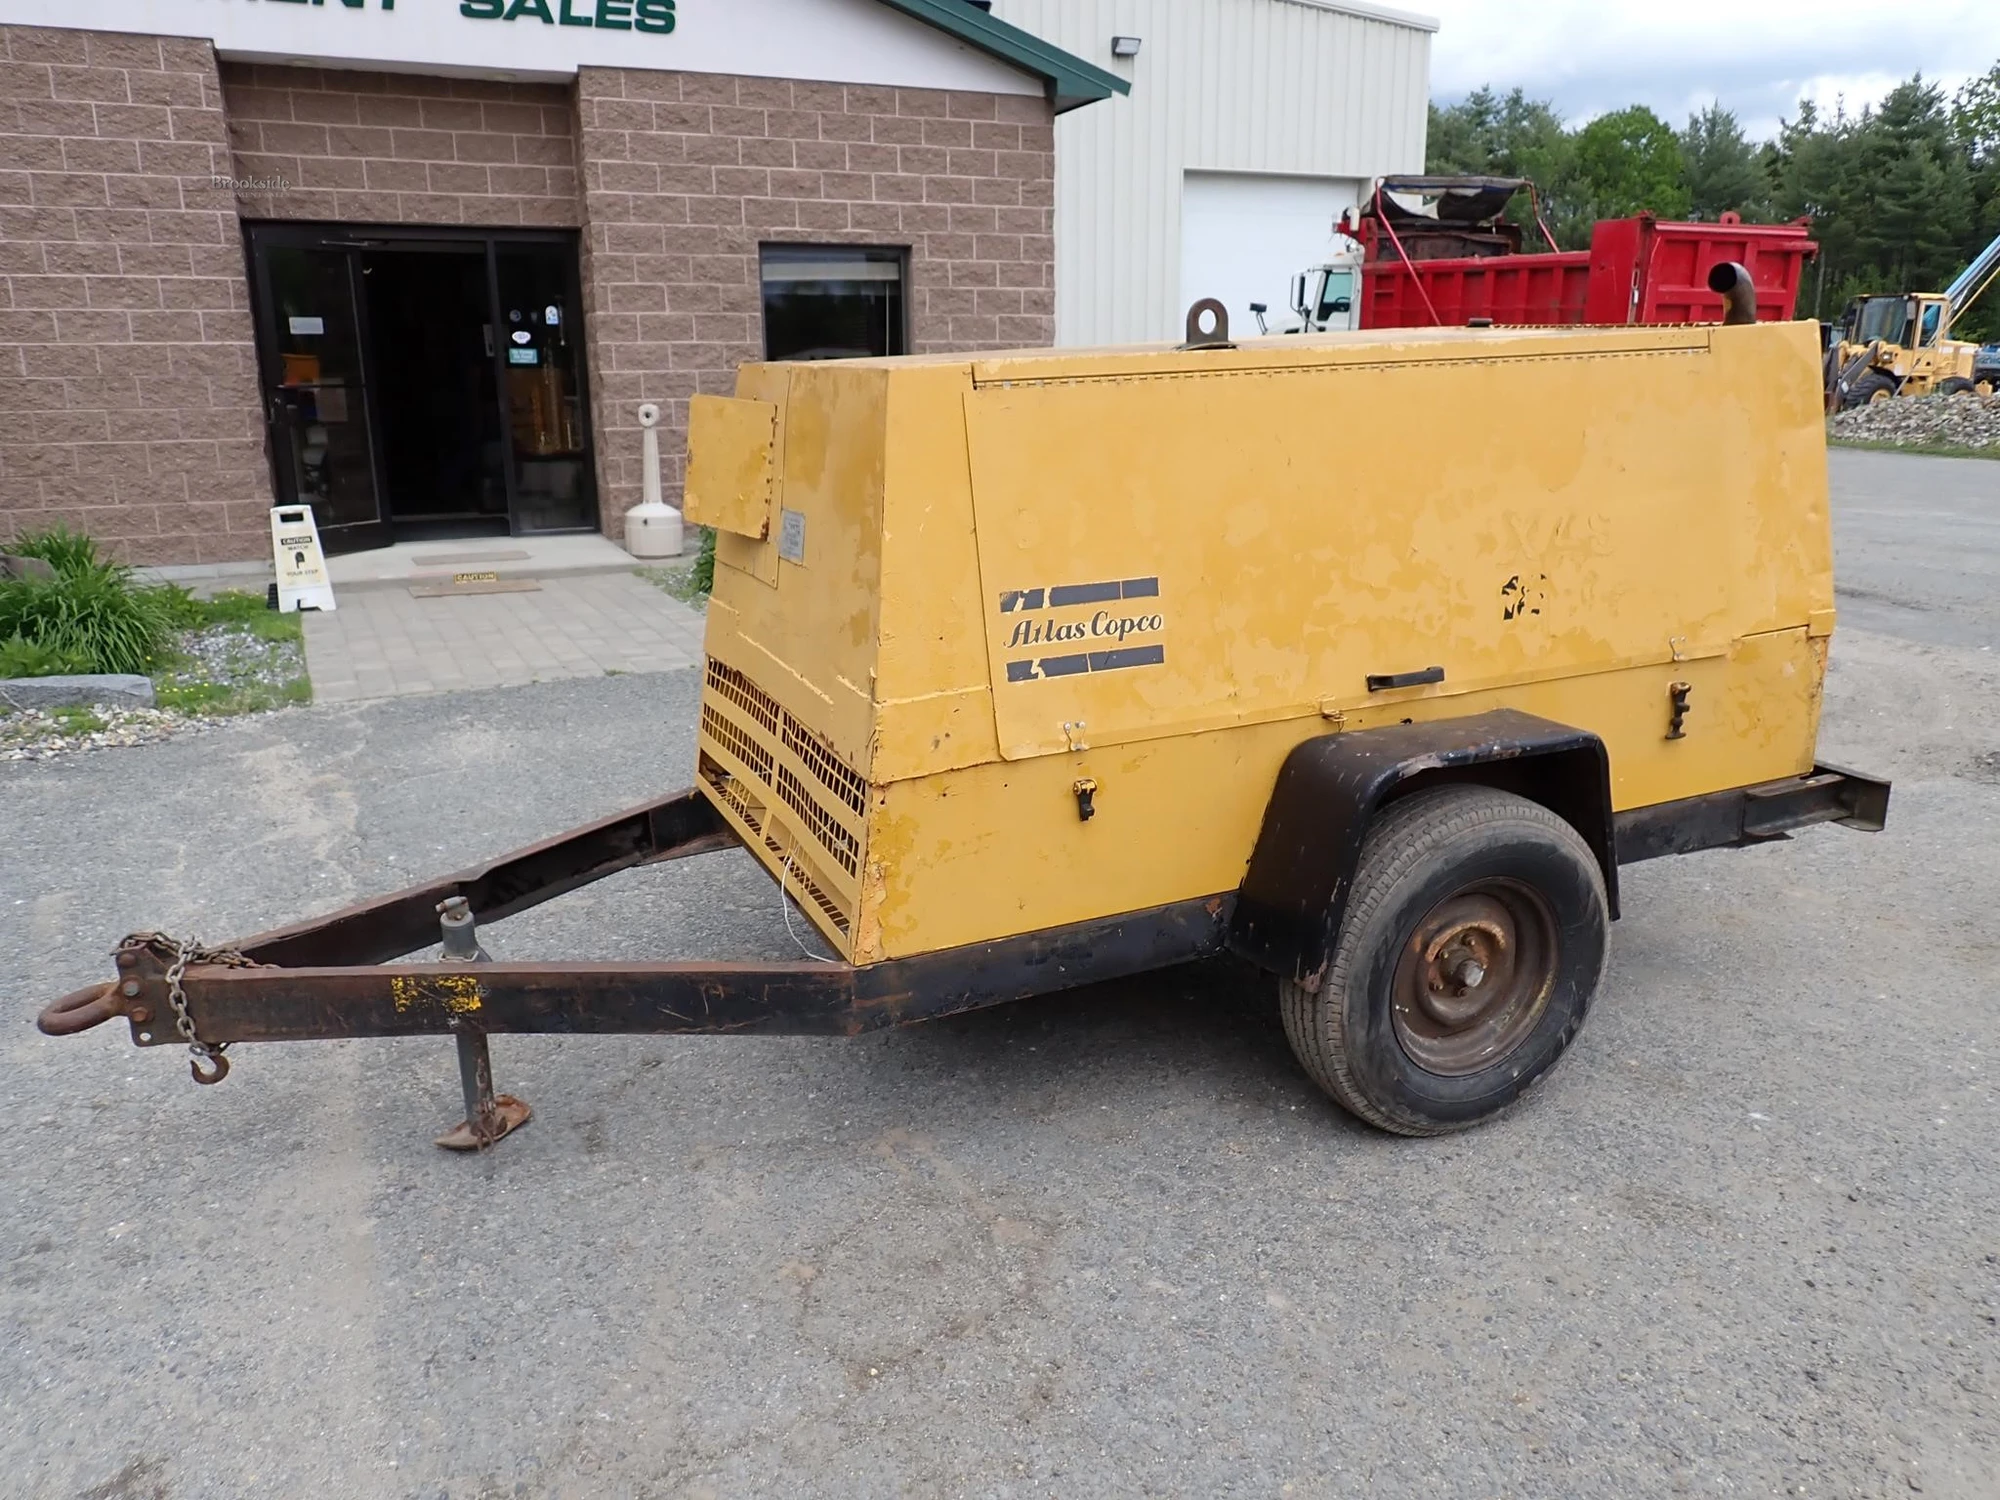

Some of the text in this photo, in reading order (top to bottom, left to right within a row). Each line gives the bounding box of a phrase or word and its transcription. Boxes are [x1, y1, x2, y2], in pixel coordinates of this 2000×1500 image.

[457, 573, 494, 581] CAUTION
[1003, 610, 1162, 648] Atlas Copco
